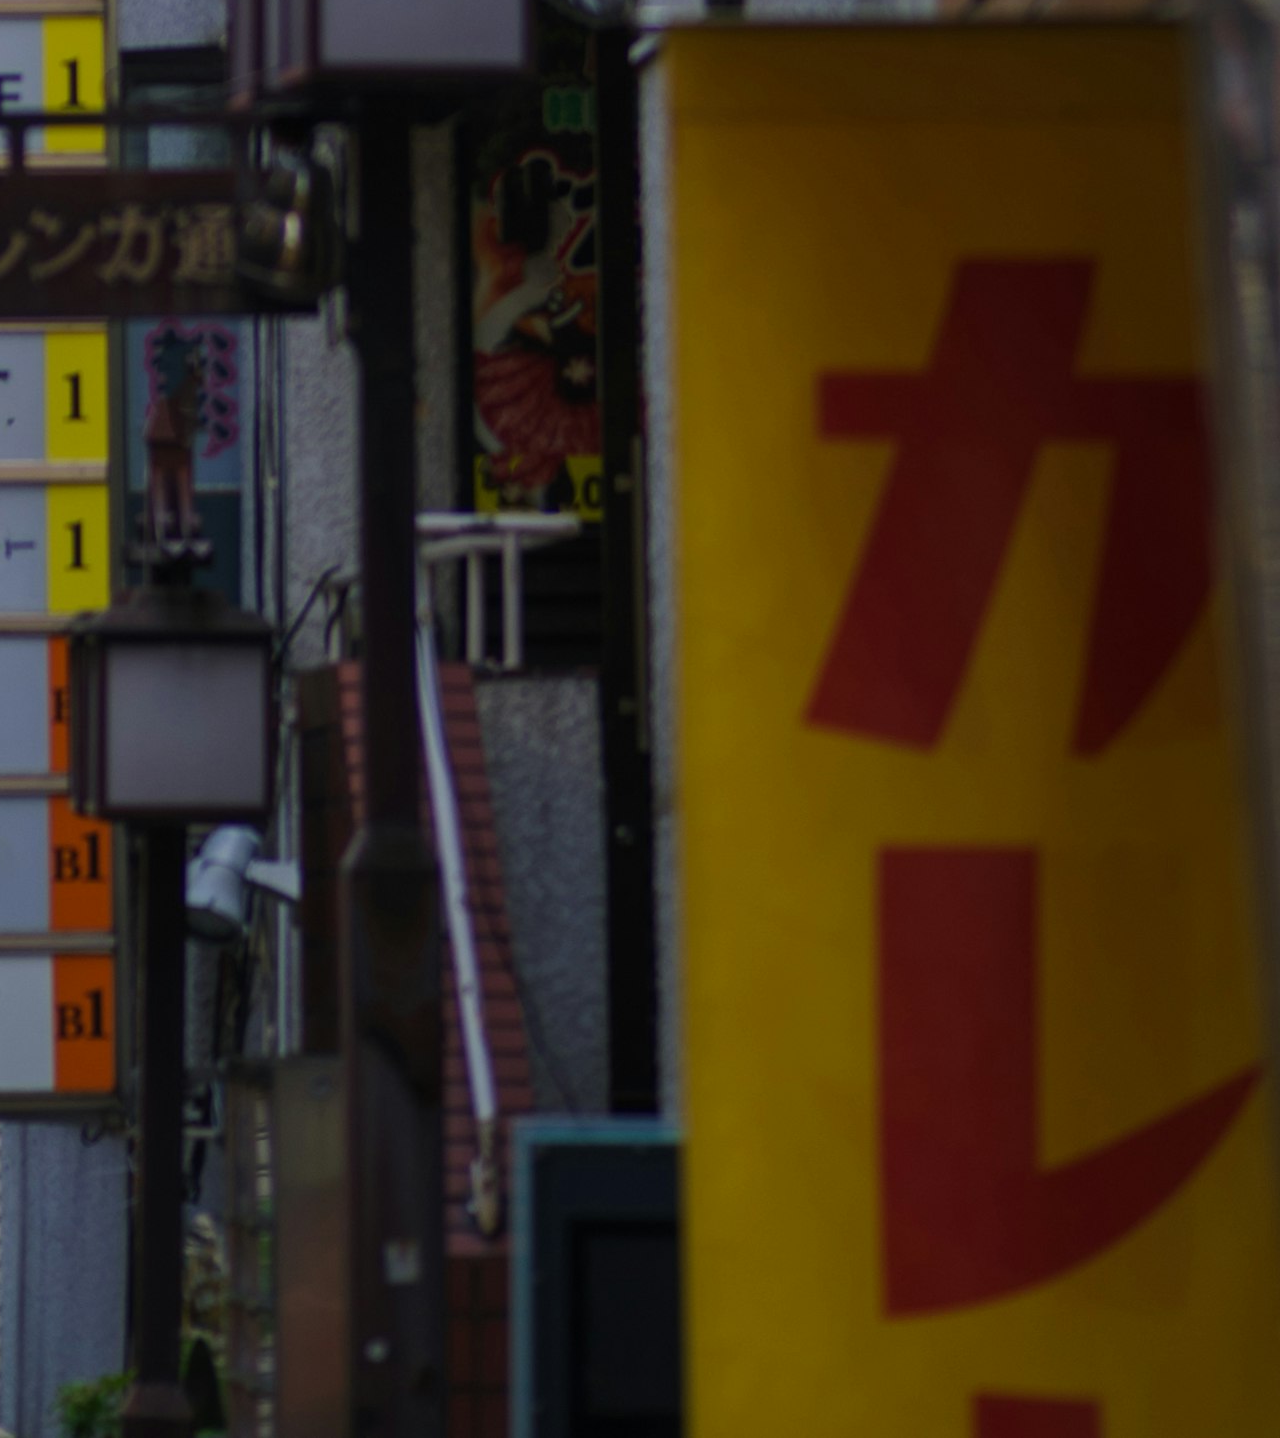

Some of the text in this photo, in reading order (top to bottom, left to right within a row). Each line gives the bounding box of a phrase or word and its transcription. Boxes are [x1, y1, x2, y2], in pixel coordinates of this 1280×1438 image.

[60, 58, 83, 109] 1
[63, 372, 85, 422] 1
[65, 521, 87, 570] 1
[53, 832, 104, 883] B1
[804, 252, 1264, 1438] カレ
[56, 989, 105, 1041] B1
